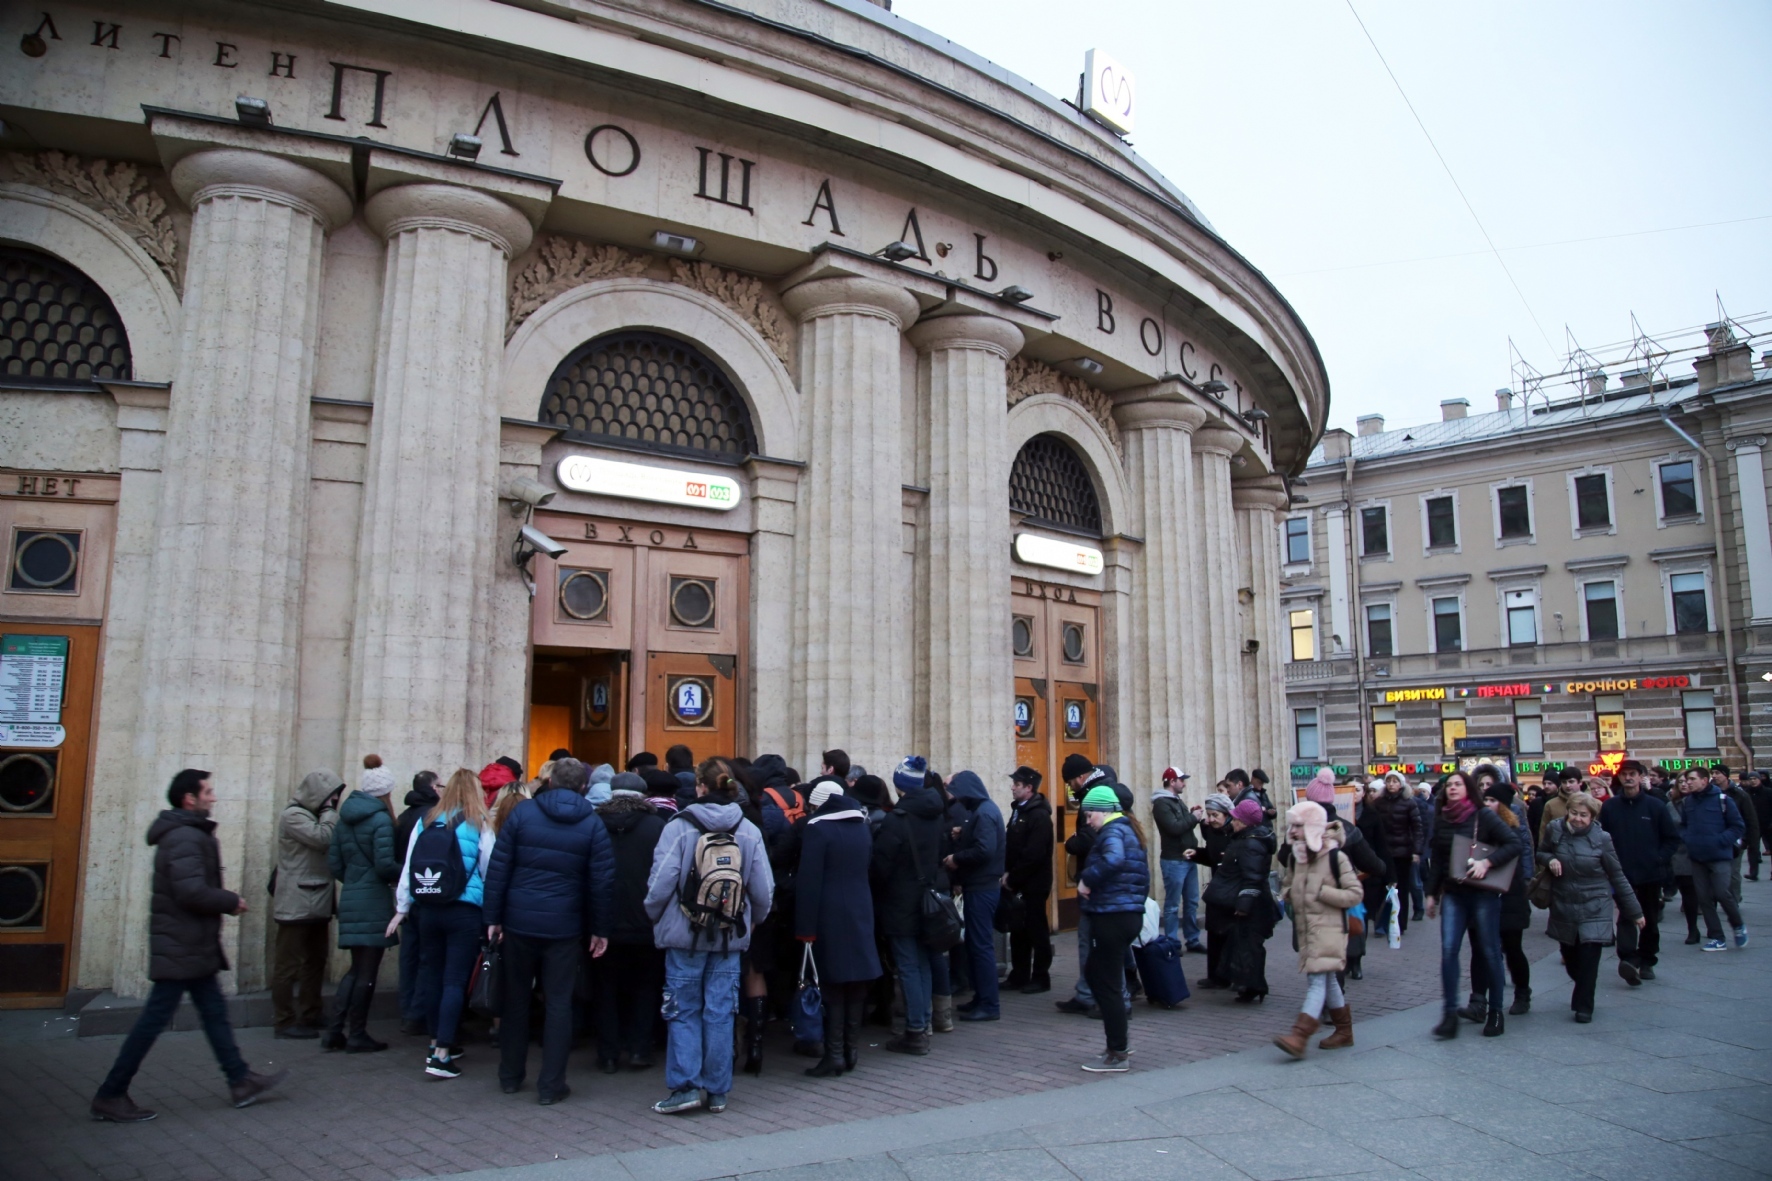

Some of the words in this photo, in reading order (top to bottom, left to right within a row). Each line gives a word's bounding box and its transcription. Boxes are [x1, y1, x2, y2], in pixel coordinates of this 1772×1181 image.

[324, 61, 999, 282] ПЛОЩАДЬ
[17, 475, 81, 496] НЕТ
[585, 523, 698, 549] ВХОД
[1025, 582, 1077, 602] ВХОД
[1478, 683, 1531, 698] ПЕЧАТИ
[1566, 679, 1638, 694] СРОЧНОЕ
[1642, 675, 1689, 689] ФОТО
[1386, 688, 1445, 702] ВИЗИТКИ
[1368, 760, 1424, 776] ЦВЕТНОЙ
[1660, 758, 1720, 771] ЦВЕТЫ
[415, 886, 441, 894] adidas
